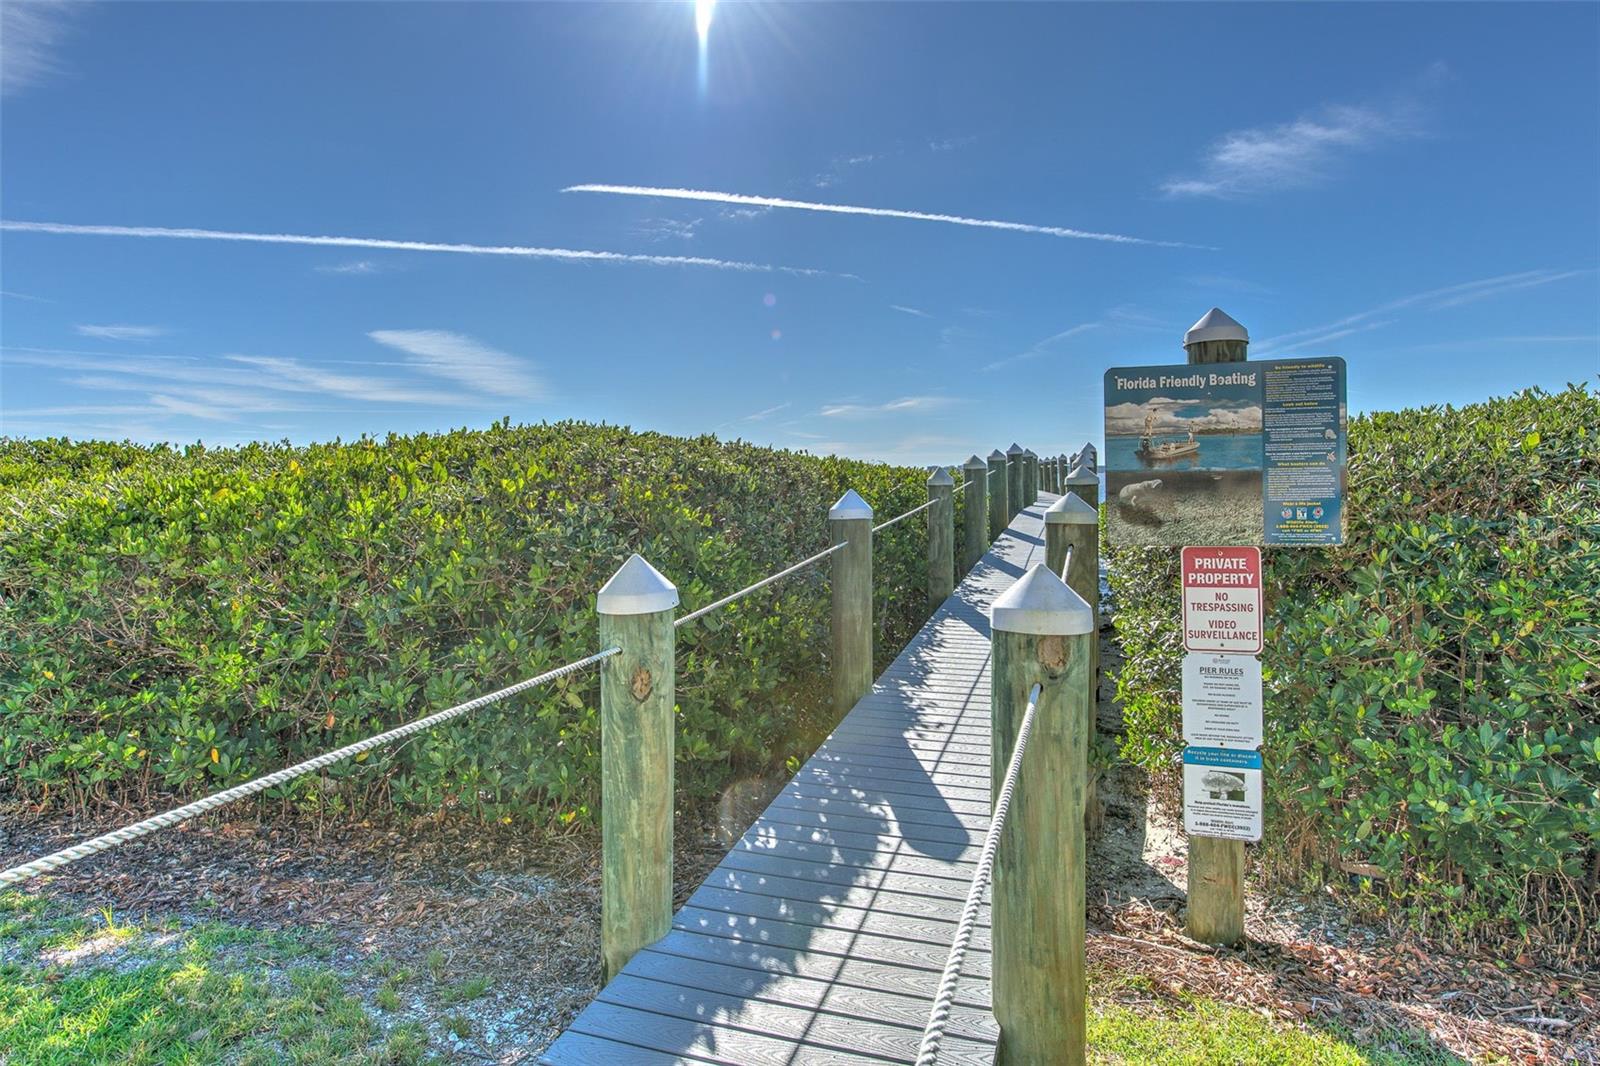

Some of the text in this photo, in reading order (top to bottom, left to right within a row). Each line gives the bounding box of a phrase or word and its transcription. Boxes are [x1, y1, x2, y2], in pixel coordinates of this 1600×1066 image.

[1117, 377, 1156, 390] Florida
[1160, 375, 1206, 389] Friendly
[1209, 372, 1256, 386] Boating
[1195, 558, 1247, 569] PRIVATE
[1188, 573, 1254, 584] PROPERTY
[1215, 592, 1228, 601] NO
[1191, 603, 1254, 612] TRESPASSING
[1208, 620, 1237, 629] VIDEO
[1188, 630, 1257, 640] SURVEILLANCE
